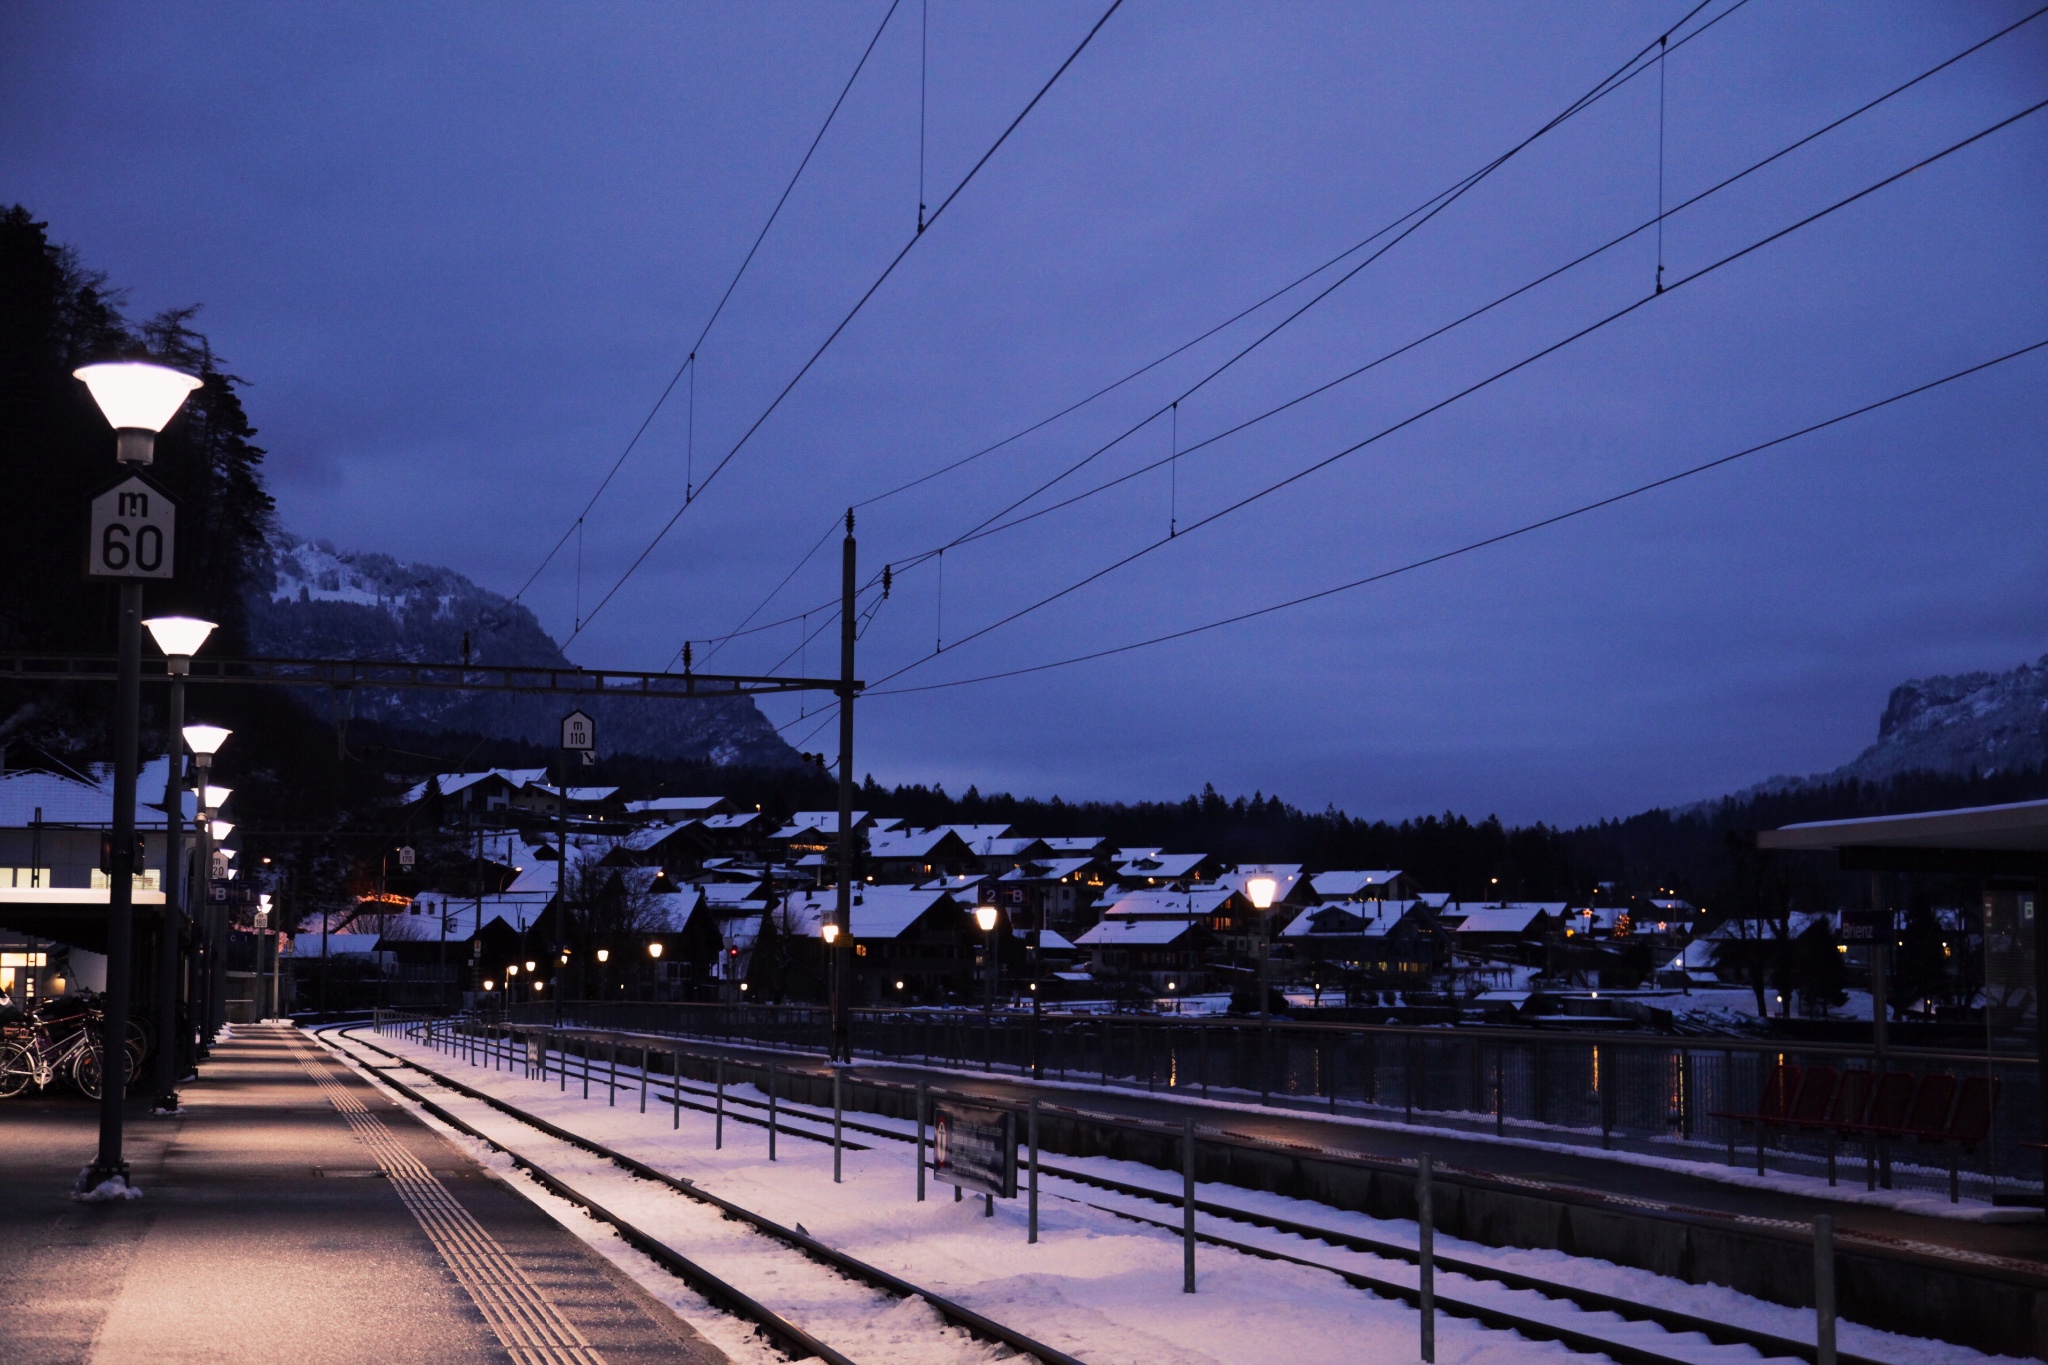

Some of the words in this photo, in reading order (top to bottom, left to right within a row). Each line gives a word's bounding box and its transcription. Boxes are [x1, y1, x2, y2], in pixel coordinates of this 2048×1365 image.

[119, 492, 148, 518] m
[103, 523, 163, 571] 60
[573, 721, 583, 731] m
[570, 732, 586, 745] 110
[402, 855, 413, 863] 170
[212, 867, 224, 876] 20
[215, 887, 227, 901] B
[244, 888, 251, 902] 1
[986, 889, 997, 903] 2
[1012, 889, 1024, 903] B
[1842, 922, 1874, 939] Brienz
